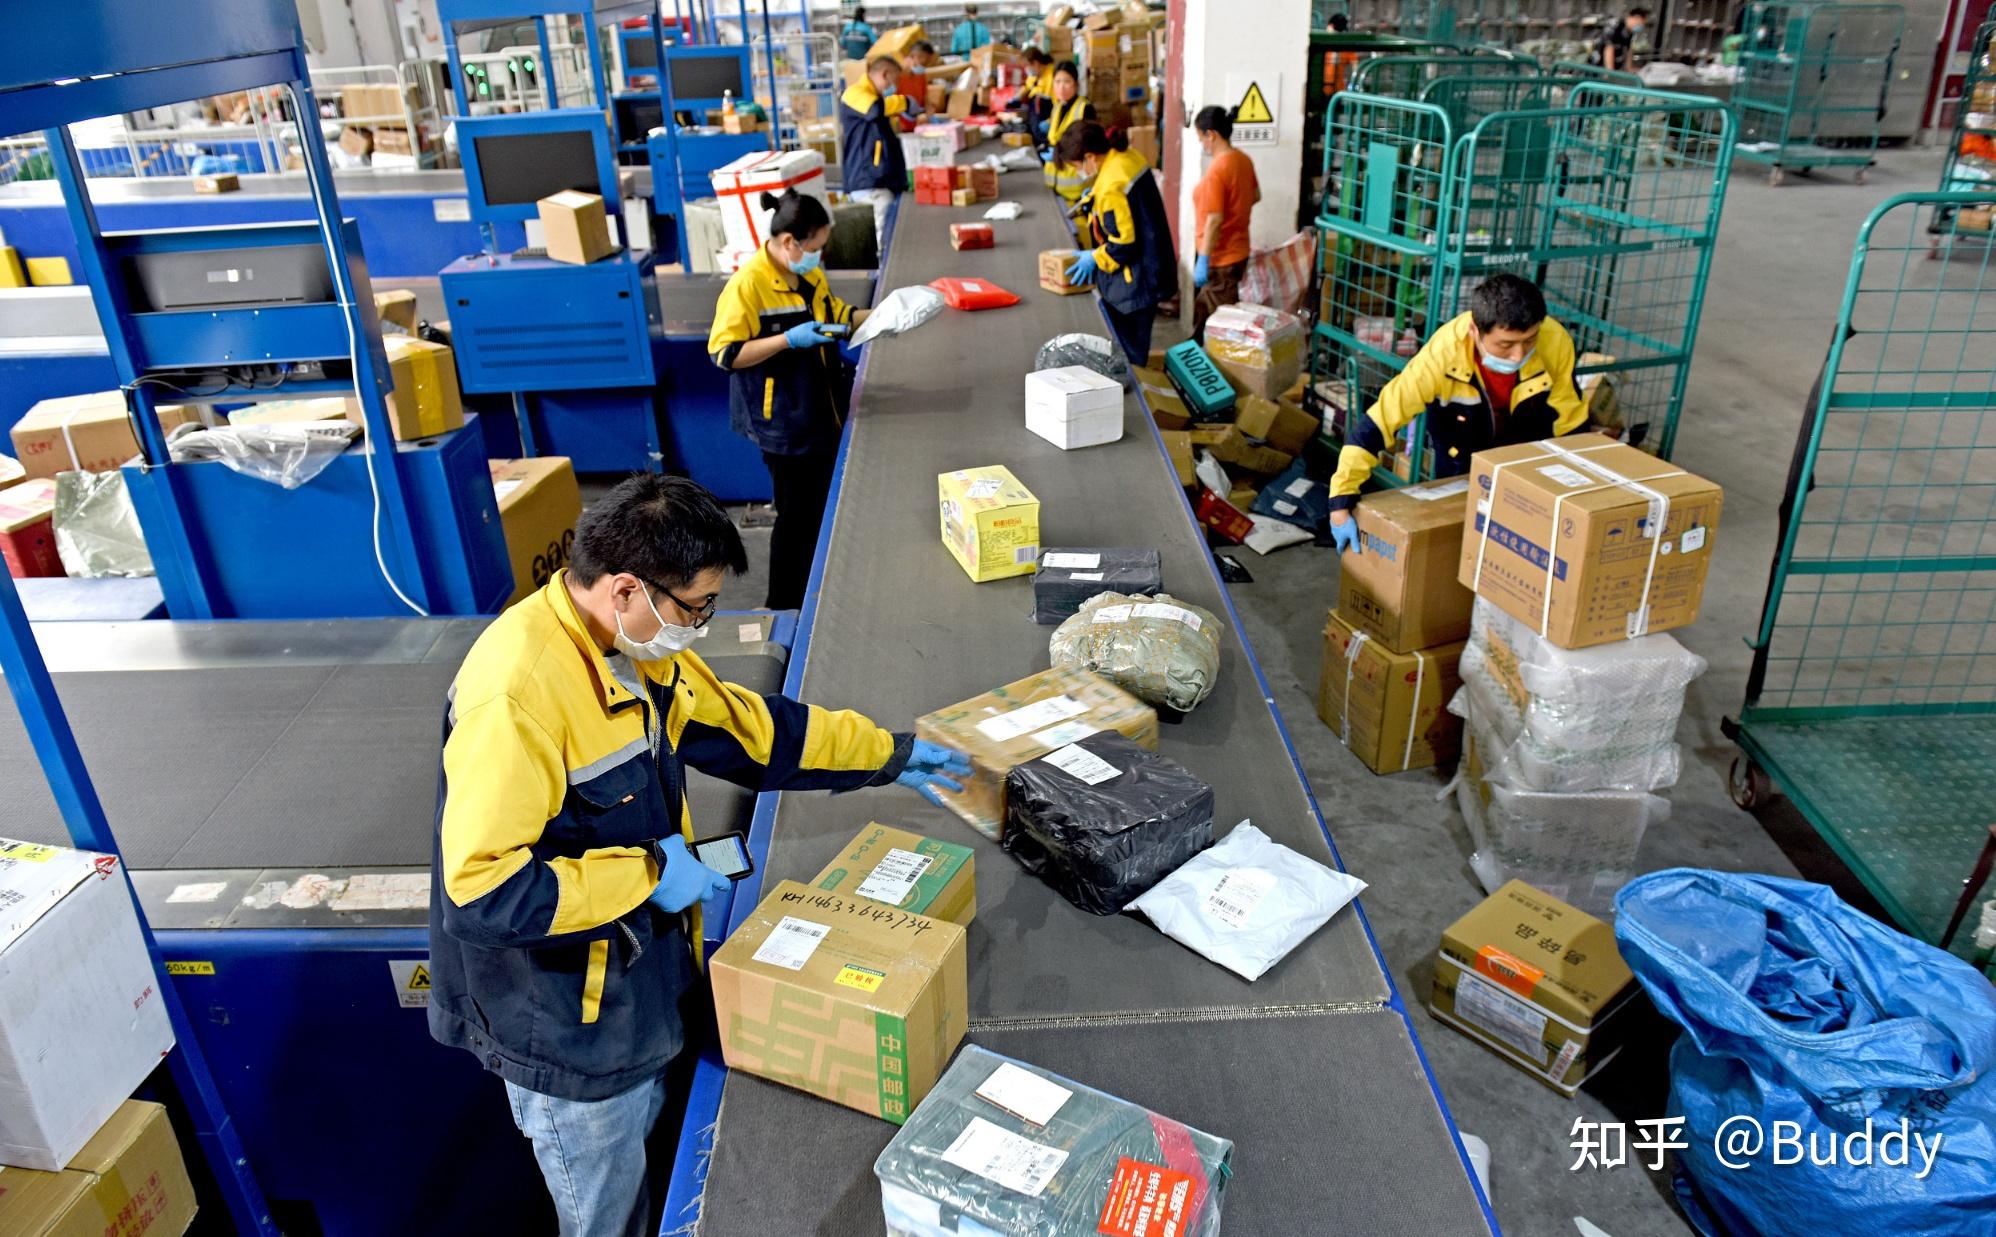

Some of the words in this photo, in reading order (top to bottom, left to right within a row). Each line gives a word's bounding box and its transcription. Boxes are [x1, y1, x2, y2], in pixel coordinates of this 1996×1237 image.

[1515, 923, 1587, 966] 易碎品
[881, 1034, 905, 1117] 中国邮政
